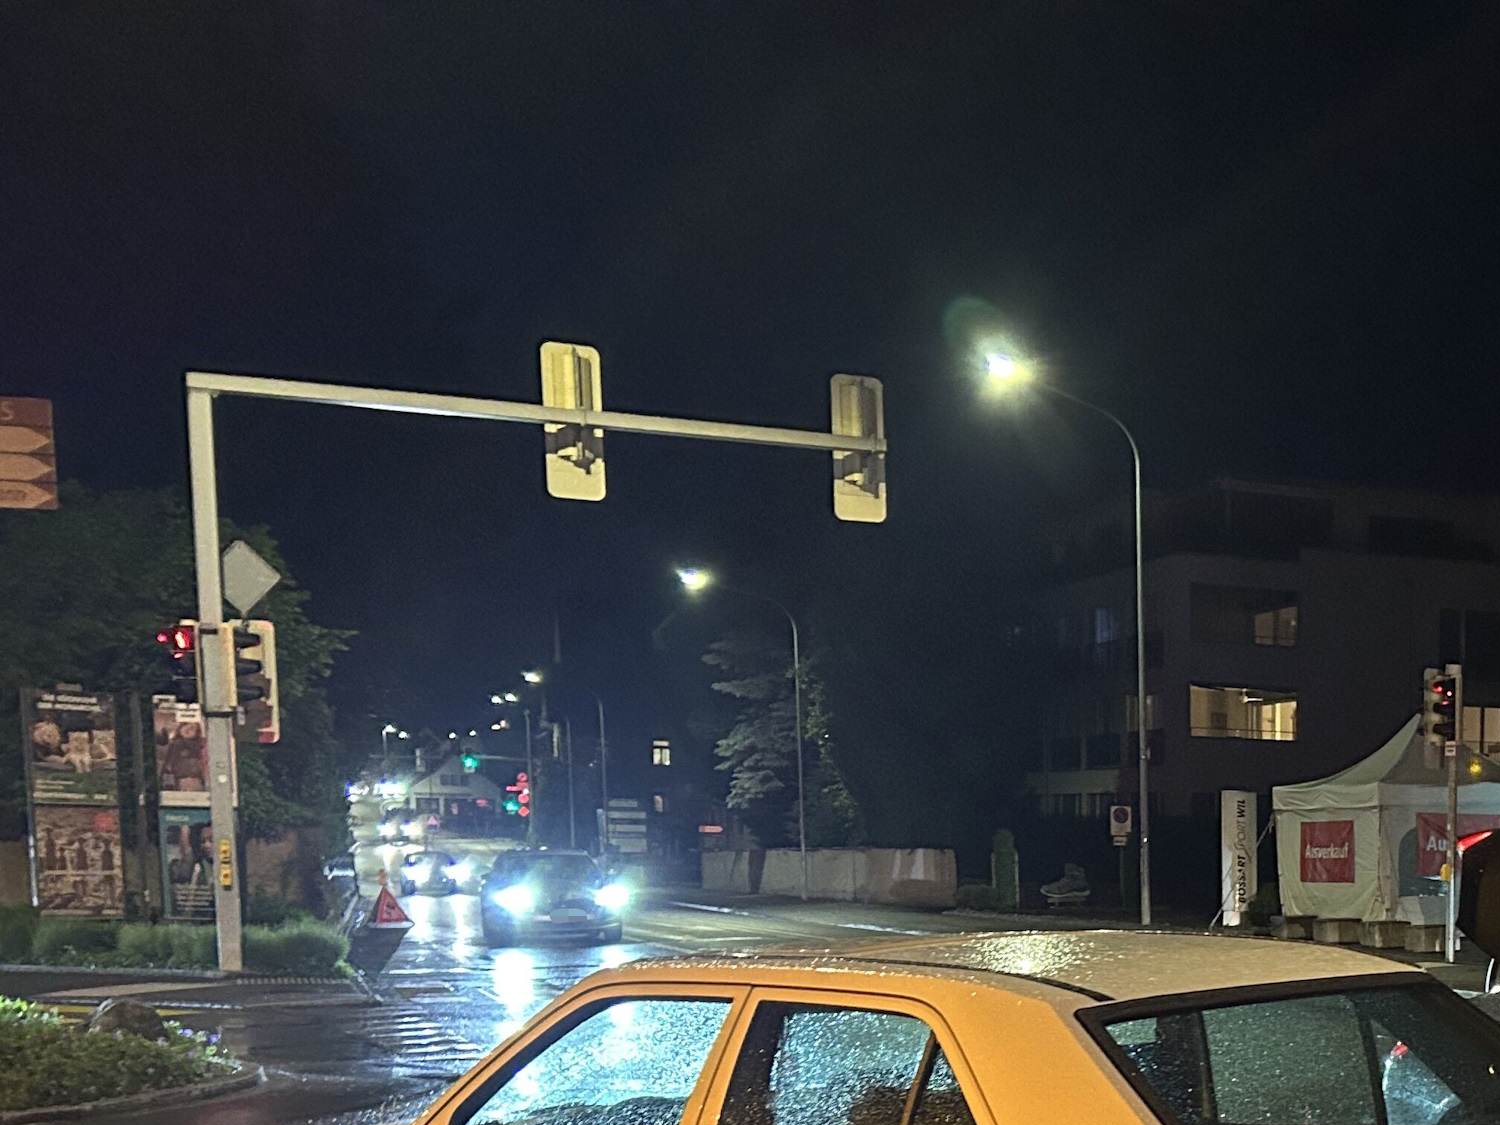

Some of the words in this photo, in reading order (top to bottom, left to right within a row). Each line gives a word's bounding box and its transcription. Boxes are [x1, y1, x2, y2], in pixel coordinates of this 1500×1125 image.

[1237, 799, 1246, 818] WIL
[1305, 842, 1349, 860] Ausverkauf
[1237, 855, 1247, 903] BOSSART
